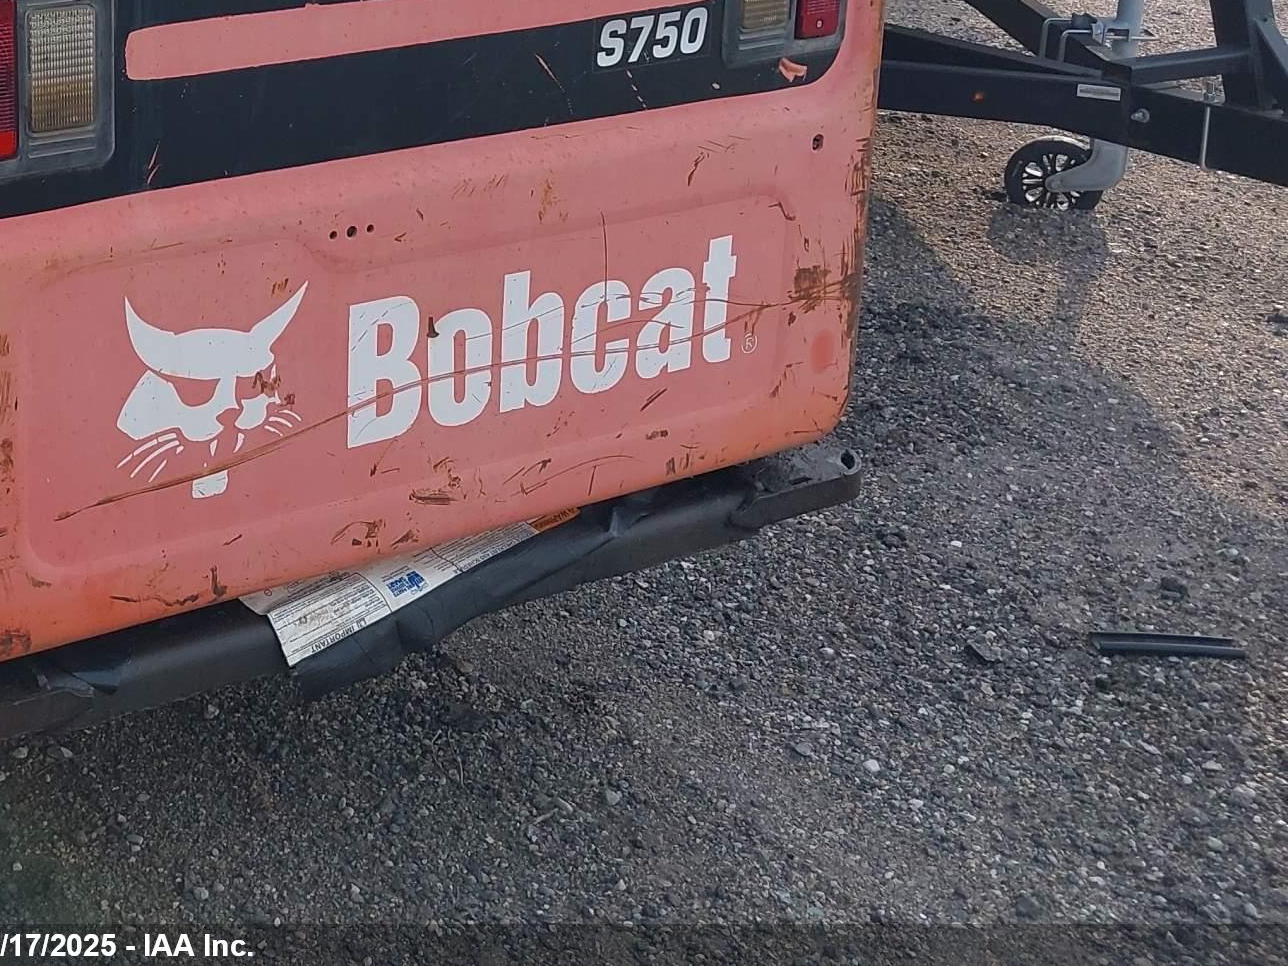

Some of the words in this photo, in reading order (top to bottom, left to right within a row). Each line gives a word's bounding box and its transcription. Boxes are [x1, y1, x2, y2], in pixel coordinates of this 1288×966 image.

[596, 6, 708, 68] S750
[346, 234, 737, 449] Bobcat
[311, 627, 355, 653] IMPORTANT
